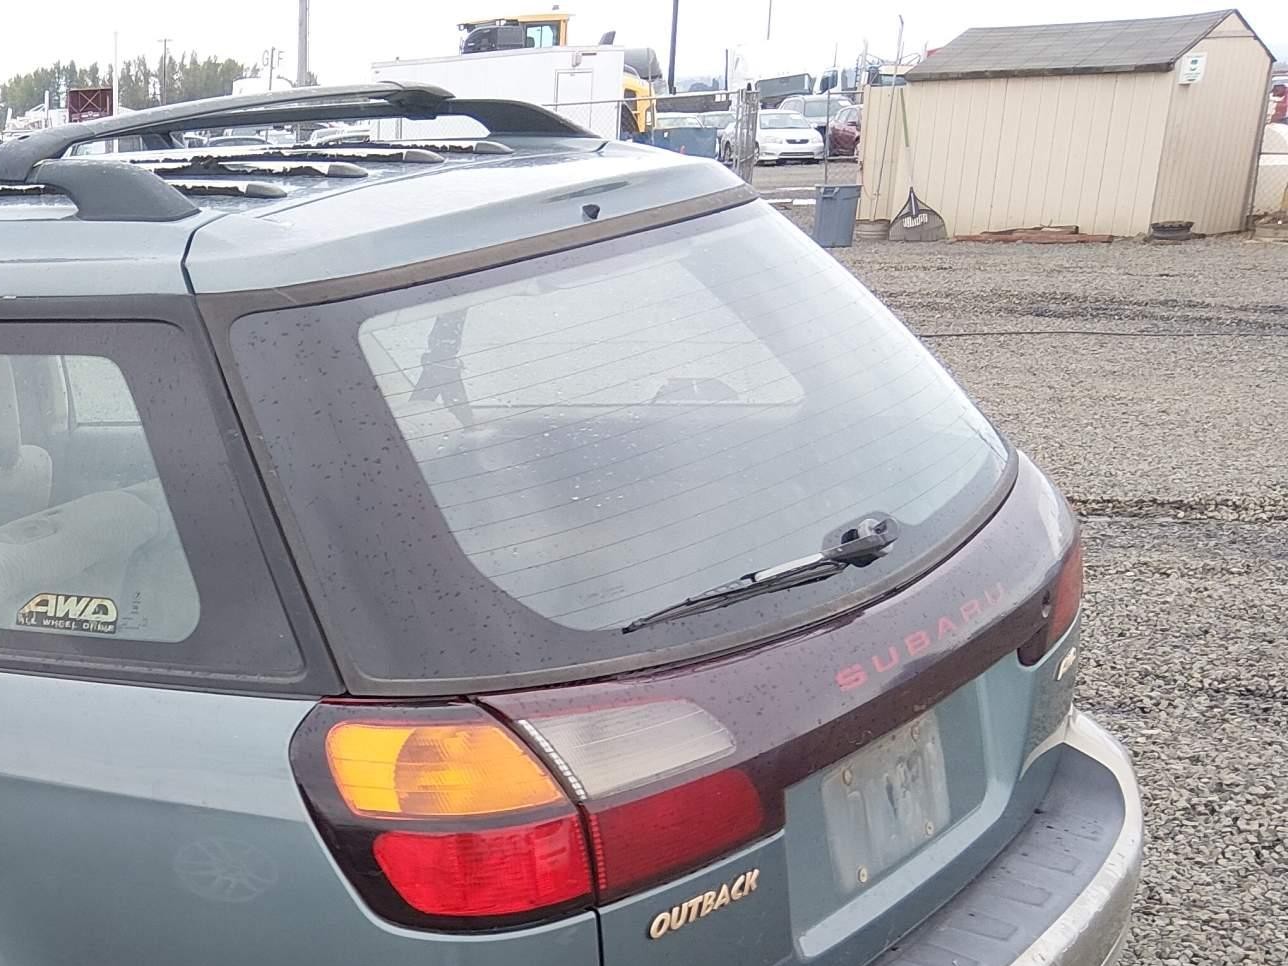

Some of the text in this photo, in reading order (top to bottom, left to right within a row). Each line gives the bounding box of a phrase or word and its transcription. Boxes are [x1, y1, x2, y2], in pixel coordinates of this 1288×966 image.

[18, 593, 117, 623] AWD
[42, 618, 77, 631] WHEEL
[834, 580, 1006, 692] SUBARU
[648, 867, 761, 940] OUTBACK
